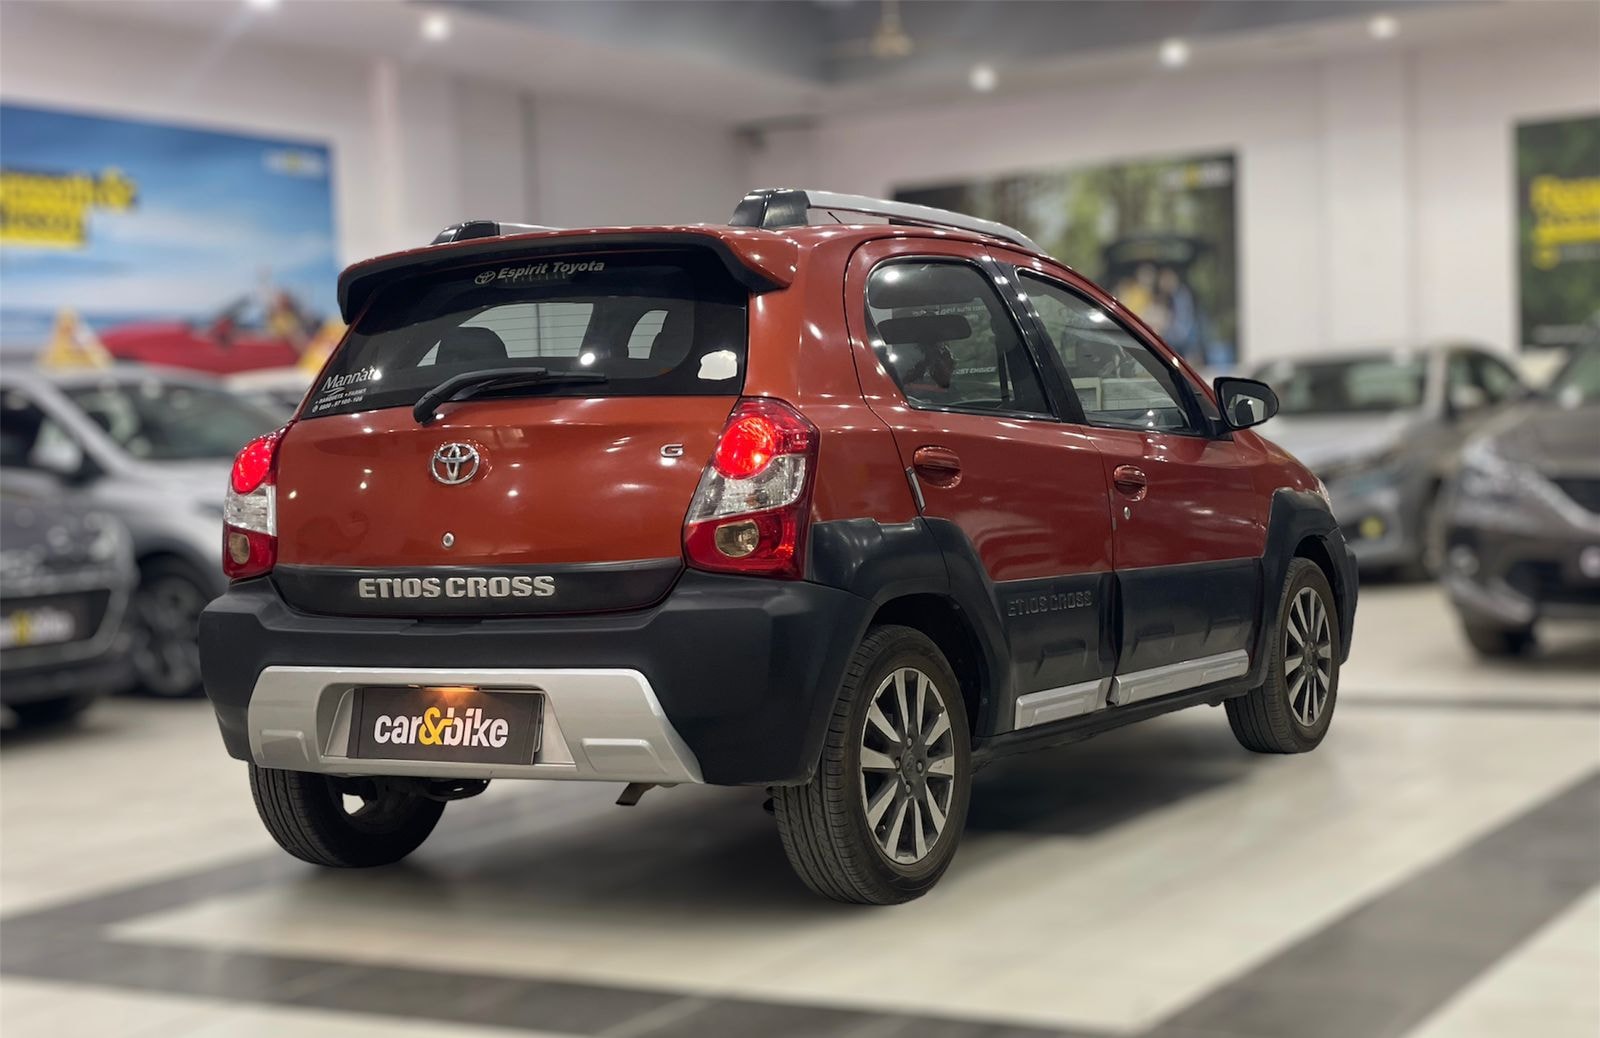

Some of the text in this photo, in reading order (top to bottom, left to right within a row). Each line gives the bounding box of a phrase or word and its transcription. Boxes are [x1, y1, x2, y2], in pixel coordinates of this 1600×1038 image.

[497, 263, 548, 279] Espirit
[551, 260, 606, 275] Toyota
[660, 443, 684, 458] G
[358, 575, 556, 599] ETIOS CROSS
[1007, 591, 1092, 616] ETIOS CROSS
[373, 706, 509, 749] car&bike
